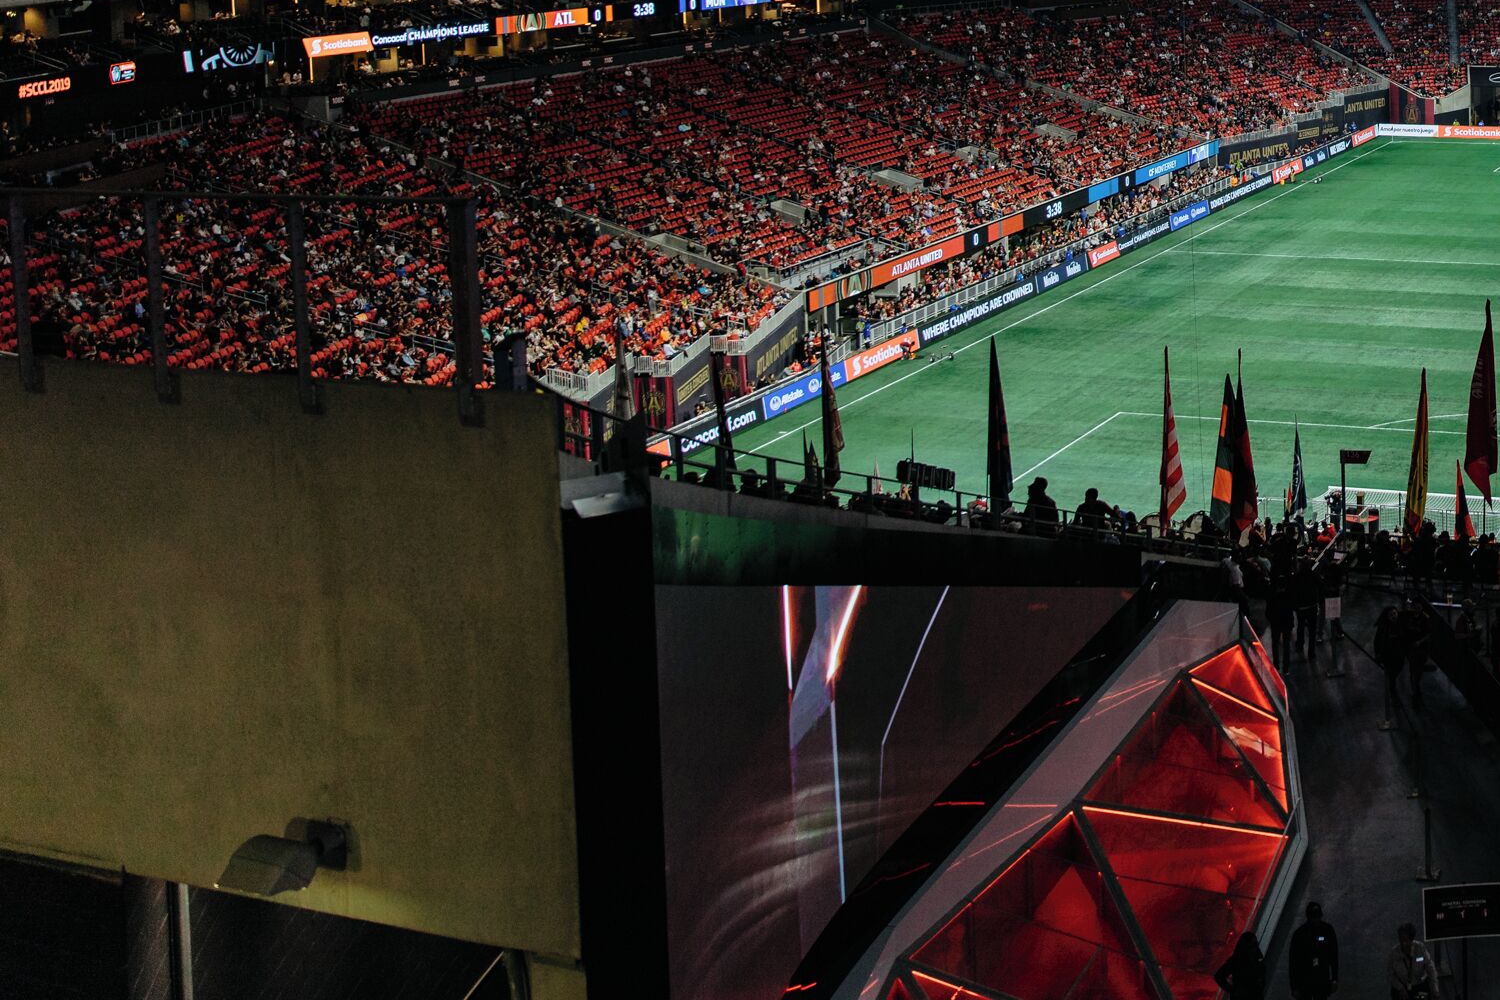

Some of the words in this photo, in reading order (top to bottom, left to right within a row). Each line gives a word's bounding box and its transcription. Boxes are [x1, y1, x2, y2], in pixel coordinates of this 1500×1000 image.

[553, 10, 576, 26] ATL
[594, 9, 602, 21] 0
[633, 2, 655, 17] 3:38
[323, 37, 369, 50] Scotiabank
[371, 31, 408, 45] Concacaf
[408, 25, 458, 41] CHAMPIONS
[458, 22, 489, 35] LEAGUE
[18, 77, 71, 99] #SCCL2019
[1364, 97, 1386, 110] UNITED
[1229, 148, 1261, 164] ATLANTA
[1148, 167, 1155, 177] CF
[1155, 159, 1177, 175] MONTERREY
[1125, 175, 1130, 187] 0
[1210, 196, 1223, 210] DONDE
[1223, 193, 1231, 203] LOS
[1230, 183, 1251, 201] CAMPEONES
[1250, 181, 1256, 189] SE
[1255, 175, 1272, 187] CORONAN
[1046, 201, 1063, 219] 3:38
[973, 232, 979, 246] 0
[1096, 244, 1117, 261] Scotiabank
[1133, 226, 1156, 245] CHAMPIONS
[1155, 221, 1169, 234] LEAGUE
[891, 258, 920, 277] ATLANTA
[920, 249, 943, 268] UNITED
[1066, 261, 1081, 277] Modelo
[1043, 271, 1060, 288] Modelo
[922, 319, 950, 341] WHERE
[949, 300, 990, 326] CHAMPIONS
[989, 296, 1003, 310] ARE
[1002, 282, 1034, 304] CROWNED
